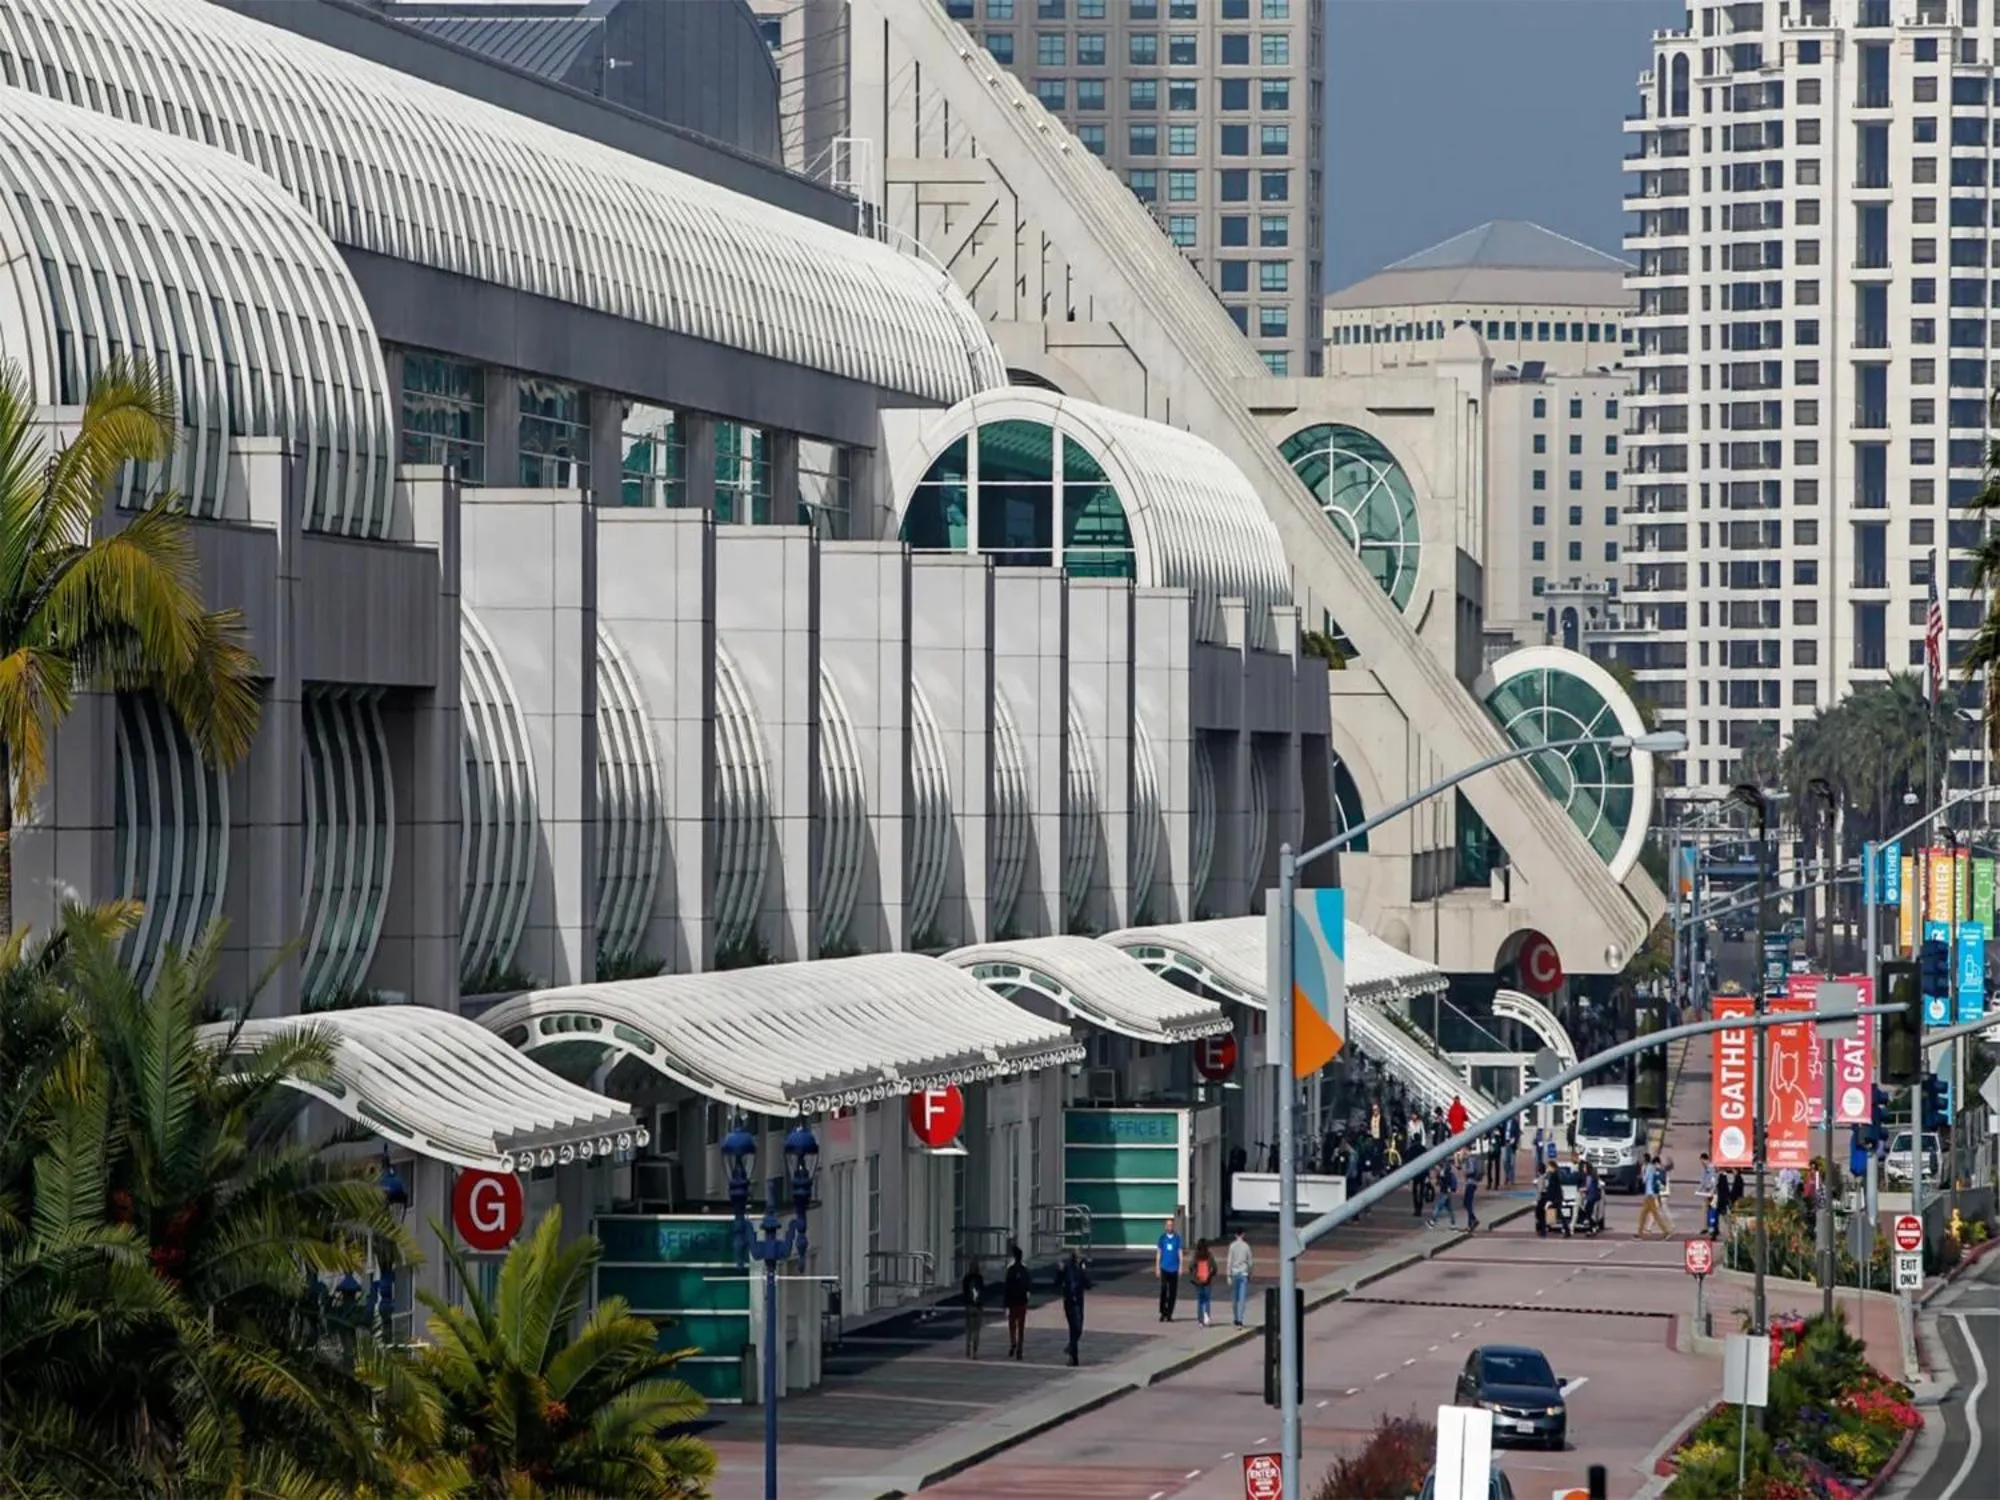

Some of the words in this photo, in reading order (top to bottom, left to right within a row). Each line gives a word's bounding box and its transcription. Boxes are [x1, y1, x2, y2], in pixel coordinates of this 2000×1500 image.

[1531, 944, 1556, 981] C
[1205, 1036, 1224, 1069] E
[925, 1090, 947, 1130] F
[469, 1178, 506, 1232] G
[1901, 1259, 1917, 1270] EXIT
[1901, 1274, 1917, 1286] ONLY
